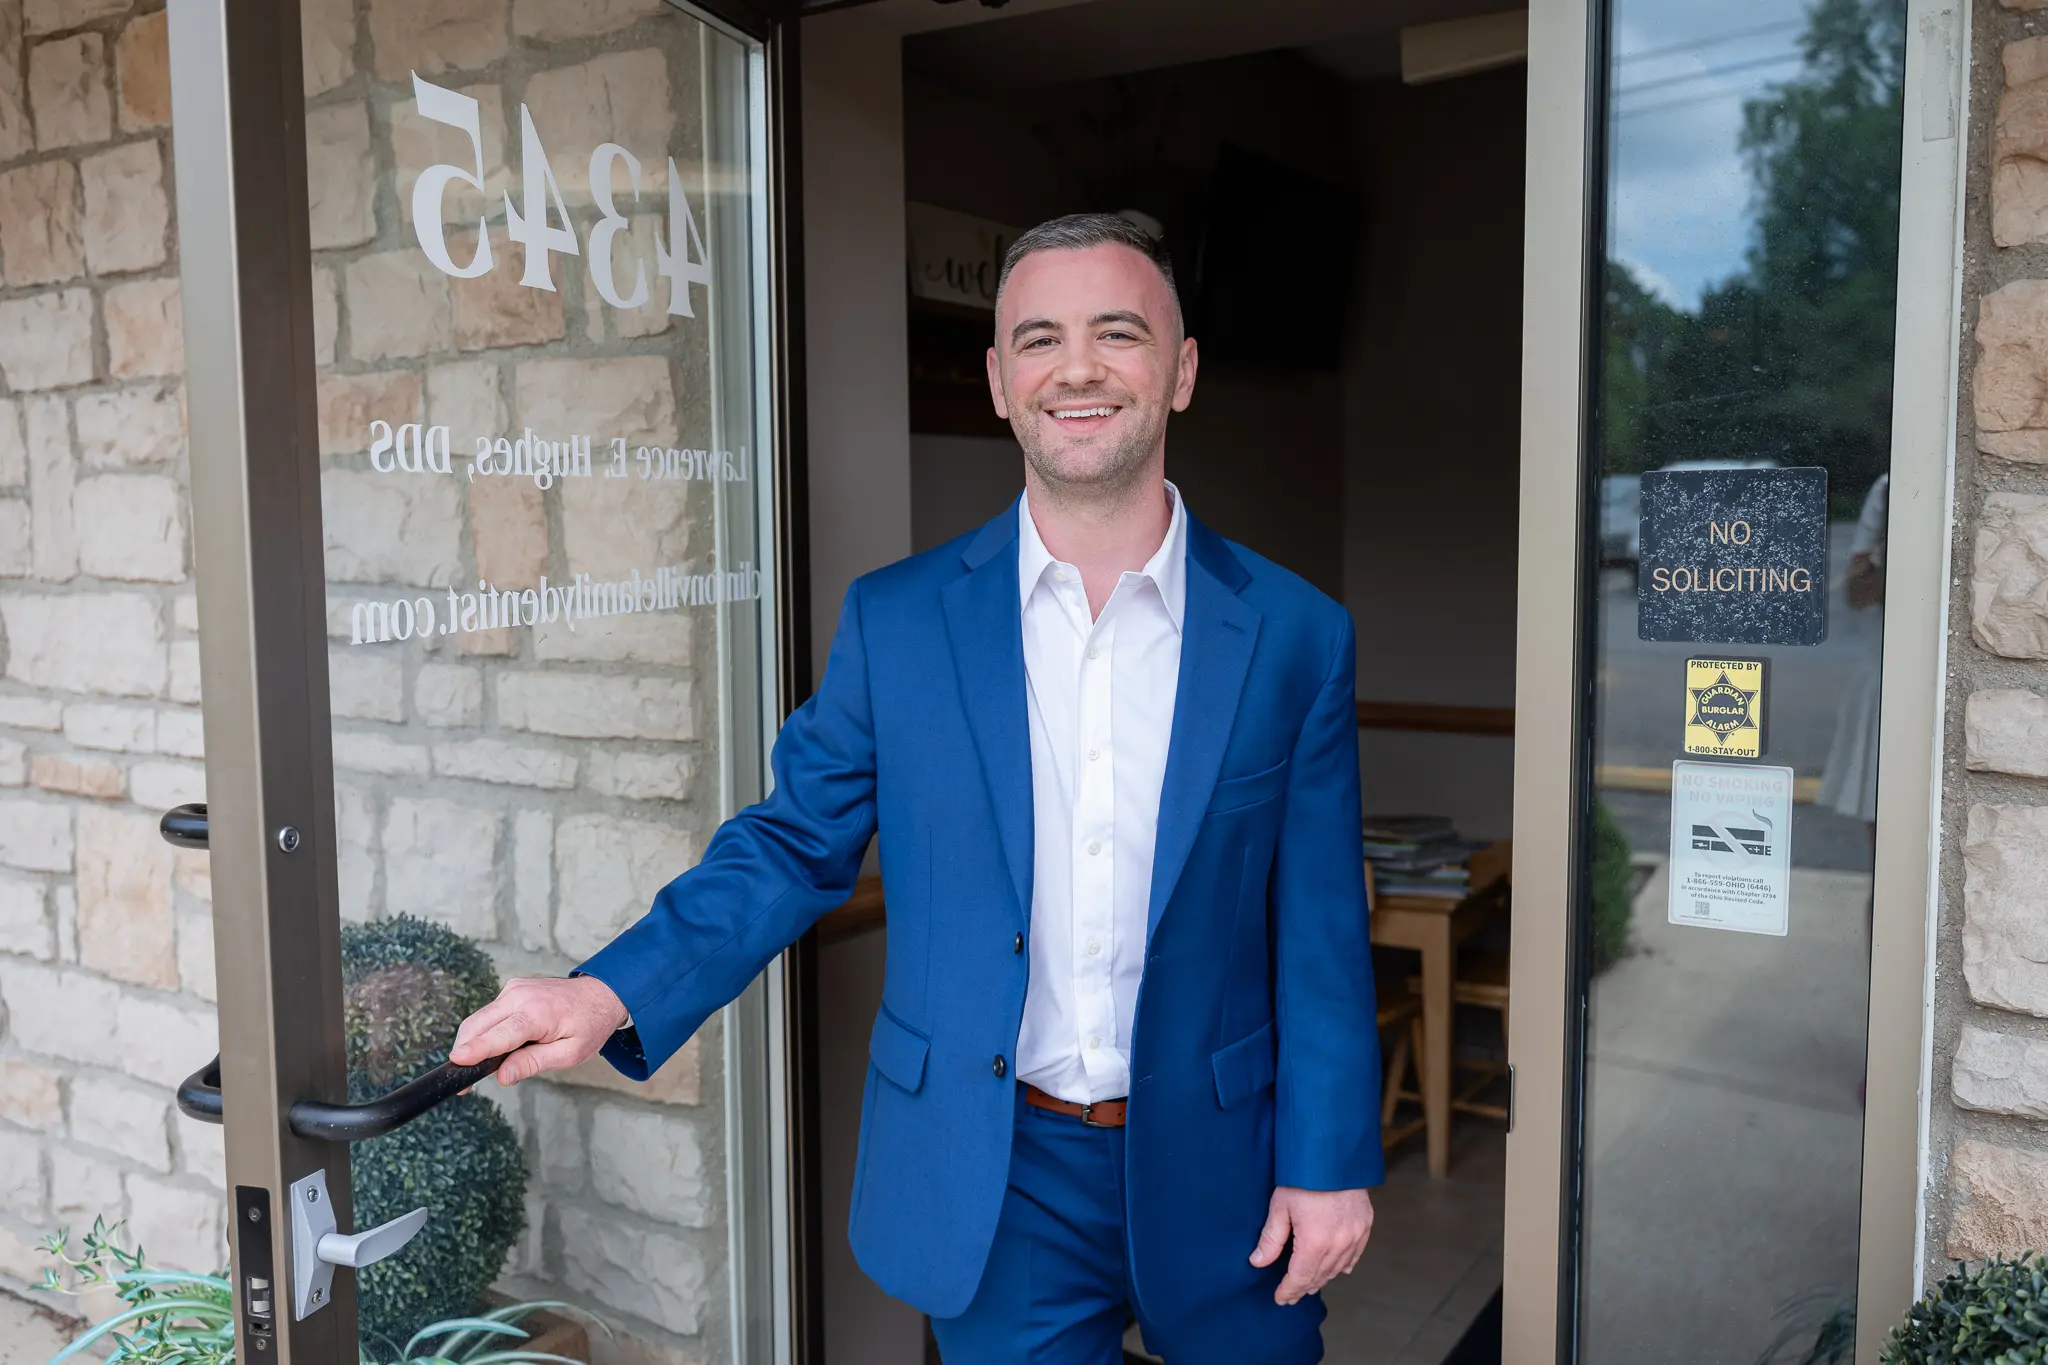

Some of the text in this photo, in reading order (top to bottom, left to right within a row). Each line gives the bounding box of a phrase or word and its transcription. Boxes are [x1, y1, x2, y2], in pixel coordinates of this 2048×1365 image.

[1709, 520, 1751, 545] NO
[1652, 567, 1811, 593] SOLICITING
[1691, 660, 1759, 670] PROTECTED BY
[1701, 686, 1745, 706] GUARDIAN
[1701, 706, 1745, 715] BURGLAR
[1705, 719, 1740, 731] ALARM
[1688, 745, 1756, 757] 1-800-STAY-OUT
[1682, 774, 1783, 793] NO SMOKING
[1689, 790, 1775, 808] NO VAPING
[1686, 877, 1771, 893] 1-866-559-OHIO (6446)
[1722, 874, 1752, 883] violations
[1687, 885, 1721, 894] accordance
[1736, 889, 1760, 898] Chapter
